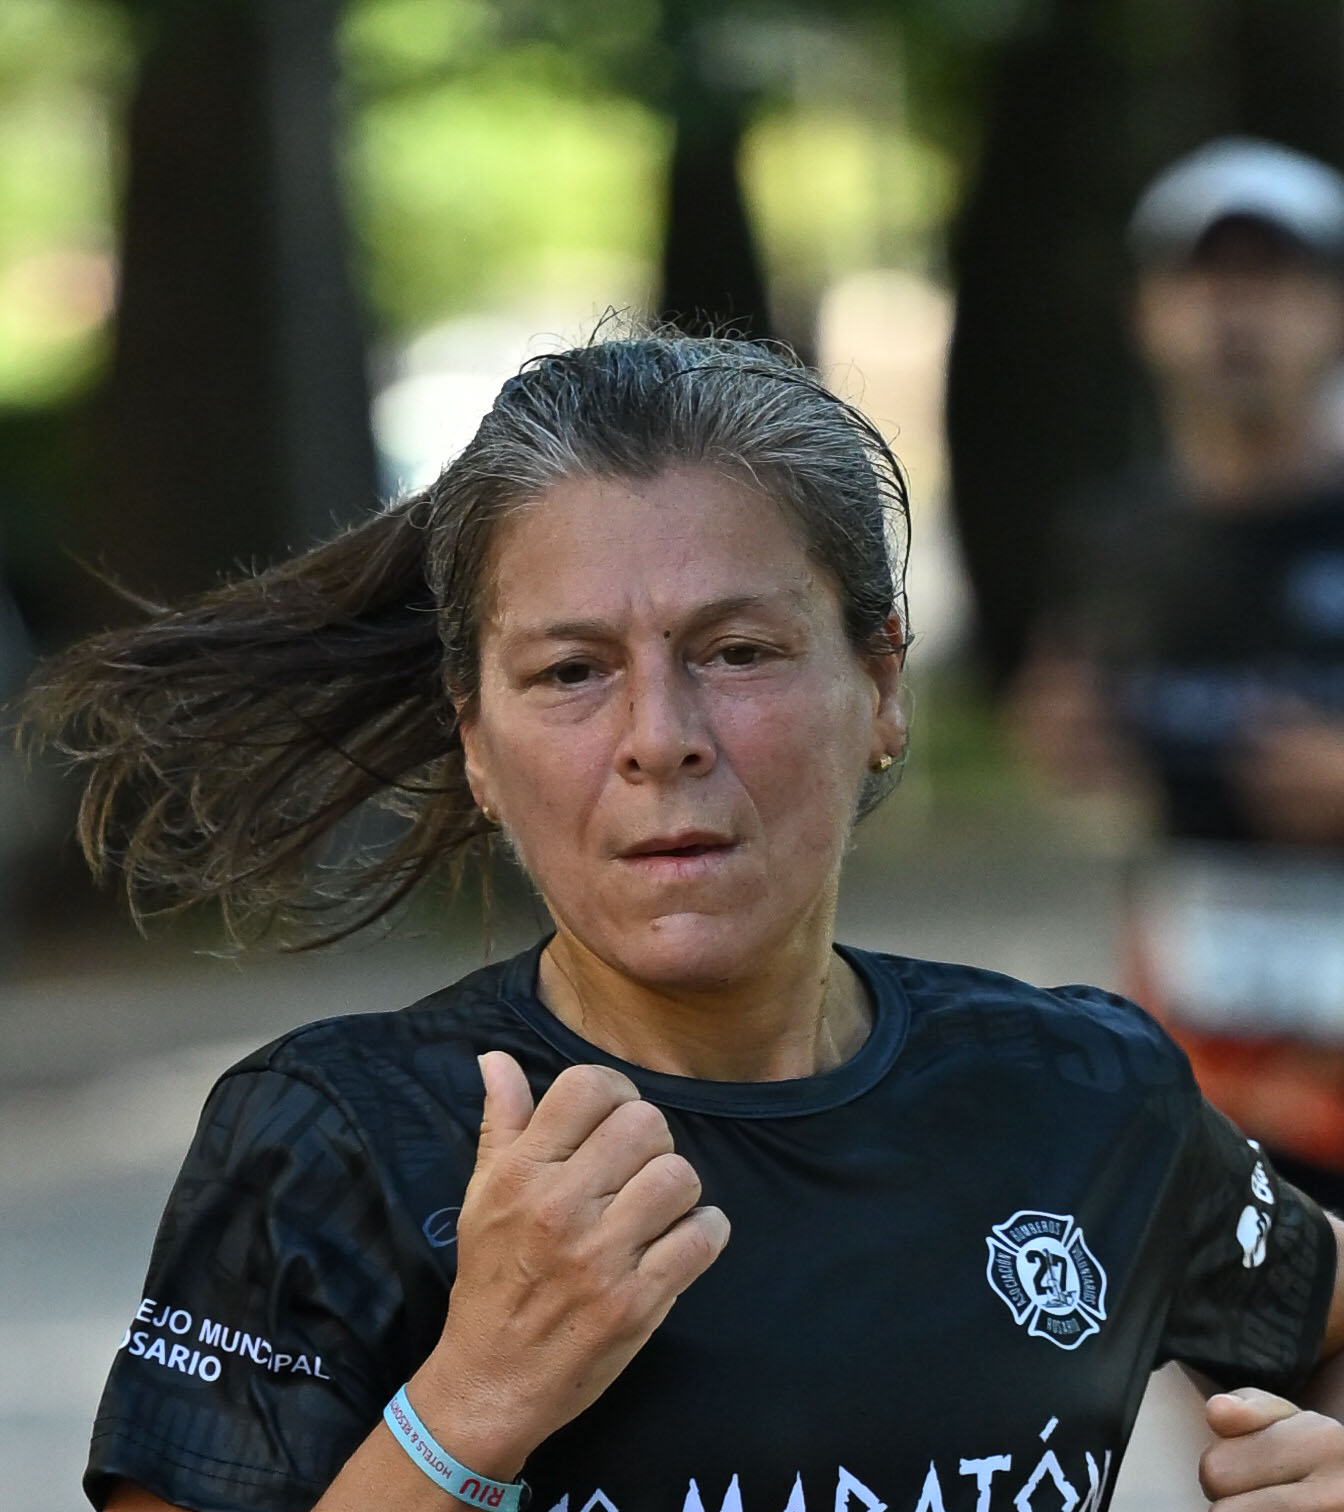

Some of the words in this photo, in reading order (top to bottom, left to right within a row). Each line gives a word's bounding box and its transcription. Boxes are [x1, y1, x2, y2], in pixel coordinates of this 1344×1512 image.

[1009, 1220, 1061, 1243] BOMBEROS
[1025, 1249, 1068, 1297] 27
[416, 1440, 453, 1480] HOTELS
[458, 1477, 505, 1508] RIU
